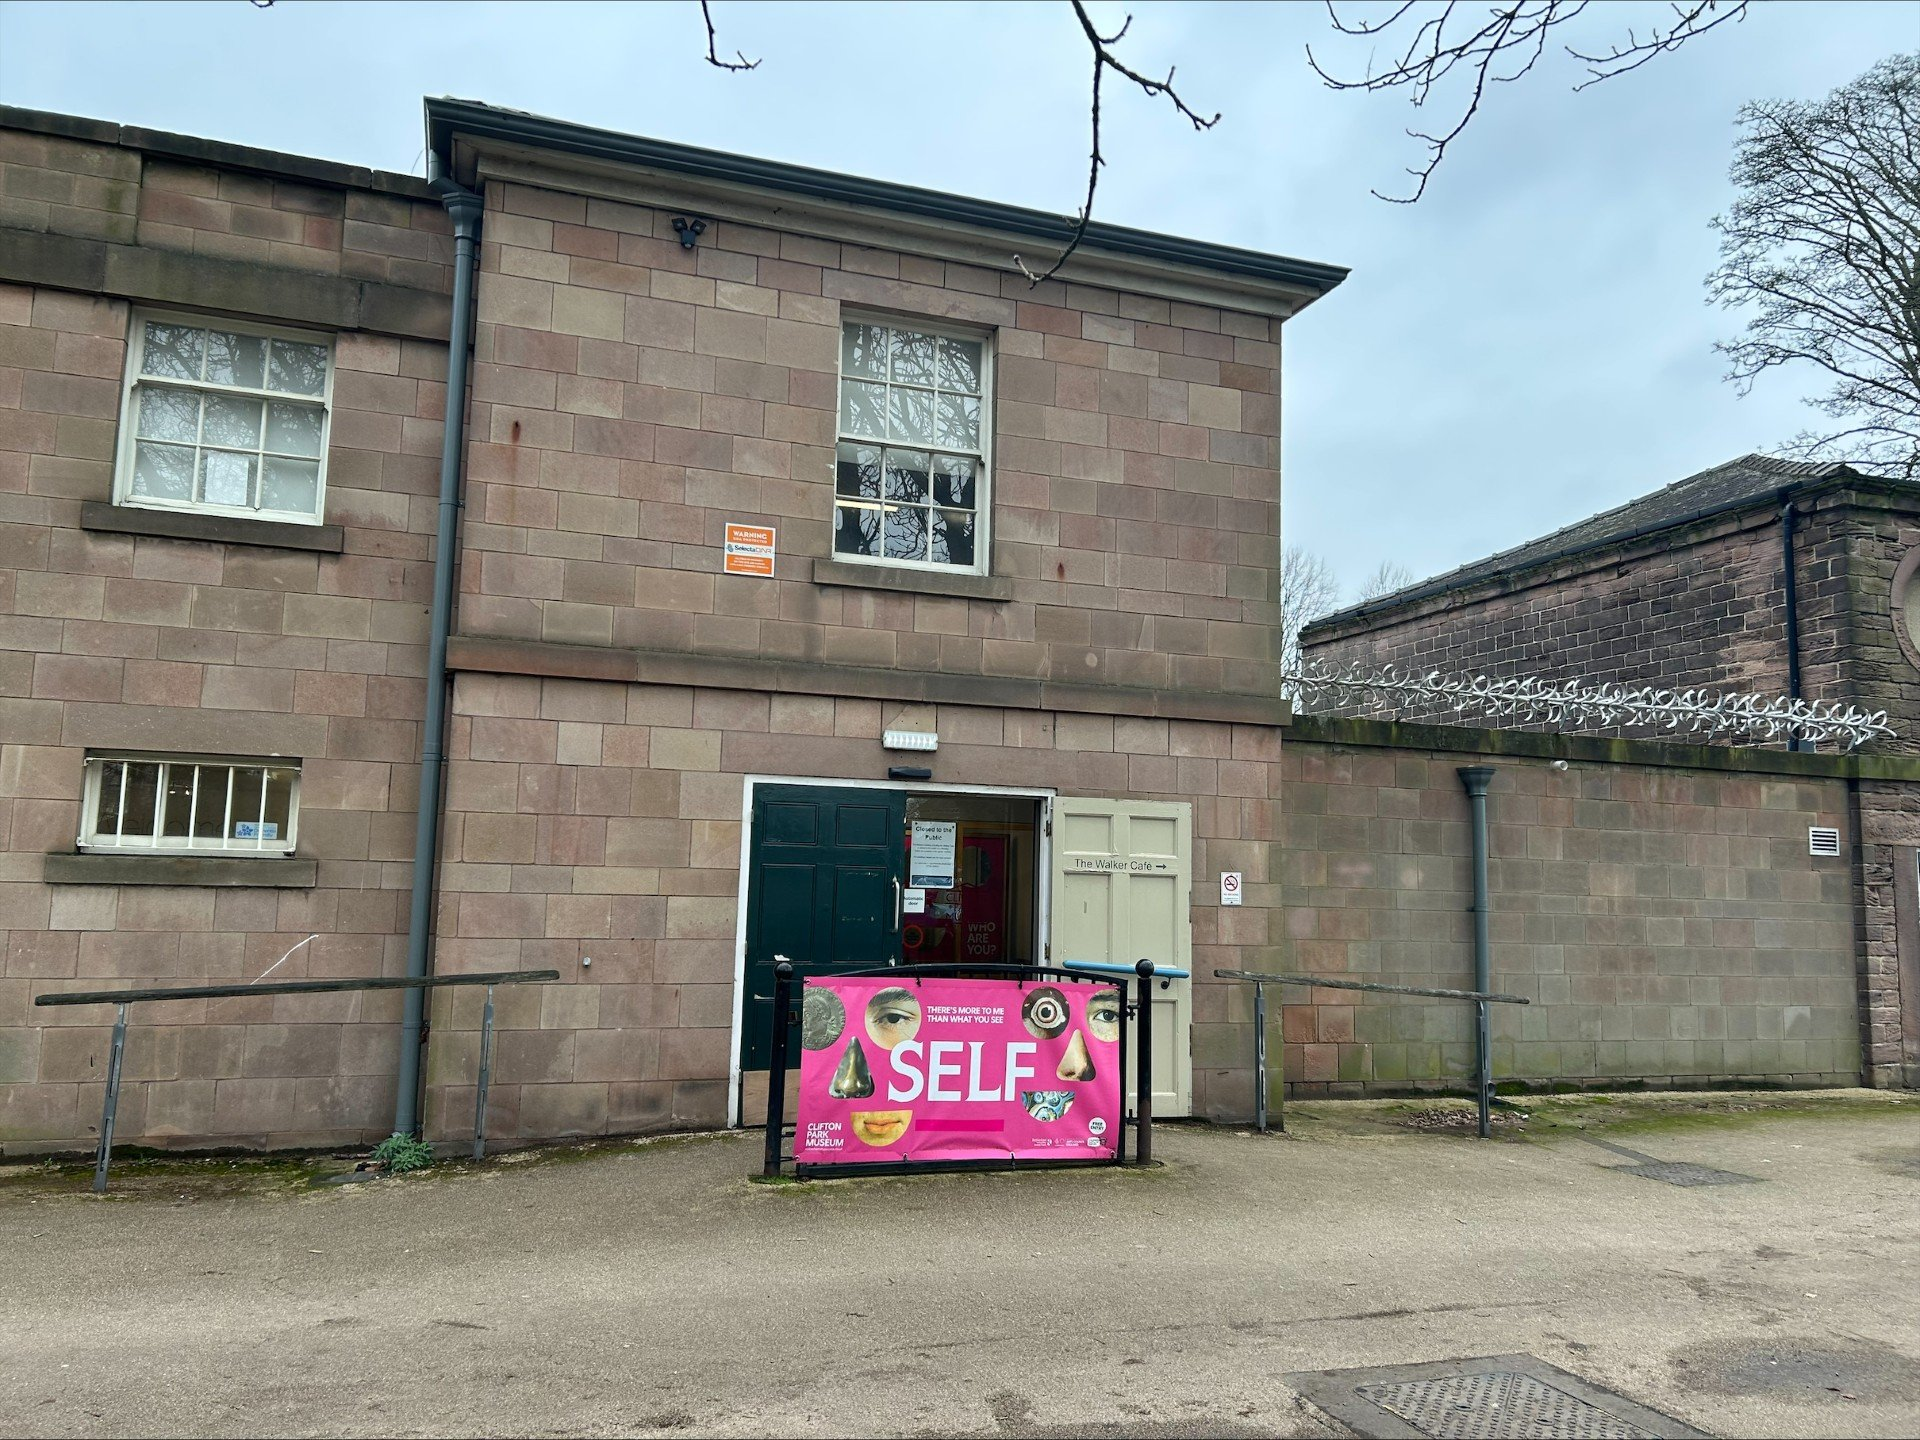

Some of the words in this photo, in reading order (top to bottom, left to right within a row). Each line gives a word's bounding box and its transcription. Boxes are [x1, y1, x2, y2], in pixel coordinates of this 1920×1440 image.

[733, 530, 767, 539] WARNING
[1075, 858, 1093, 868] The
[1095, 859, 1128, 870] Walker
[968, 922, 996, 932] WHO
[967, 933, 989, 943] ARE
[967, 945, 997, 955] YOU?
[927, 1006, 957, 1014] THERE'S
[958, 1006, 980, 1014] MORE
[993, 1007, 1004, 1015] ME
[927, 1015, 949, 1023] THAN
[950, 1015, 973, 1023] WHAT
[973, 1016, 989, 1024] YOU
[990, 1016, 1004, 1024] SEE
[887, 1039, 1037, 1102] SELF
[807, 1122, 842, 1131] CLIFTON
[806, 1130, 829, 1139] PARK
[805, 1138, 844, 1147] MUSEUM
